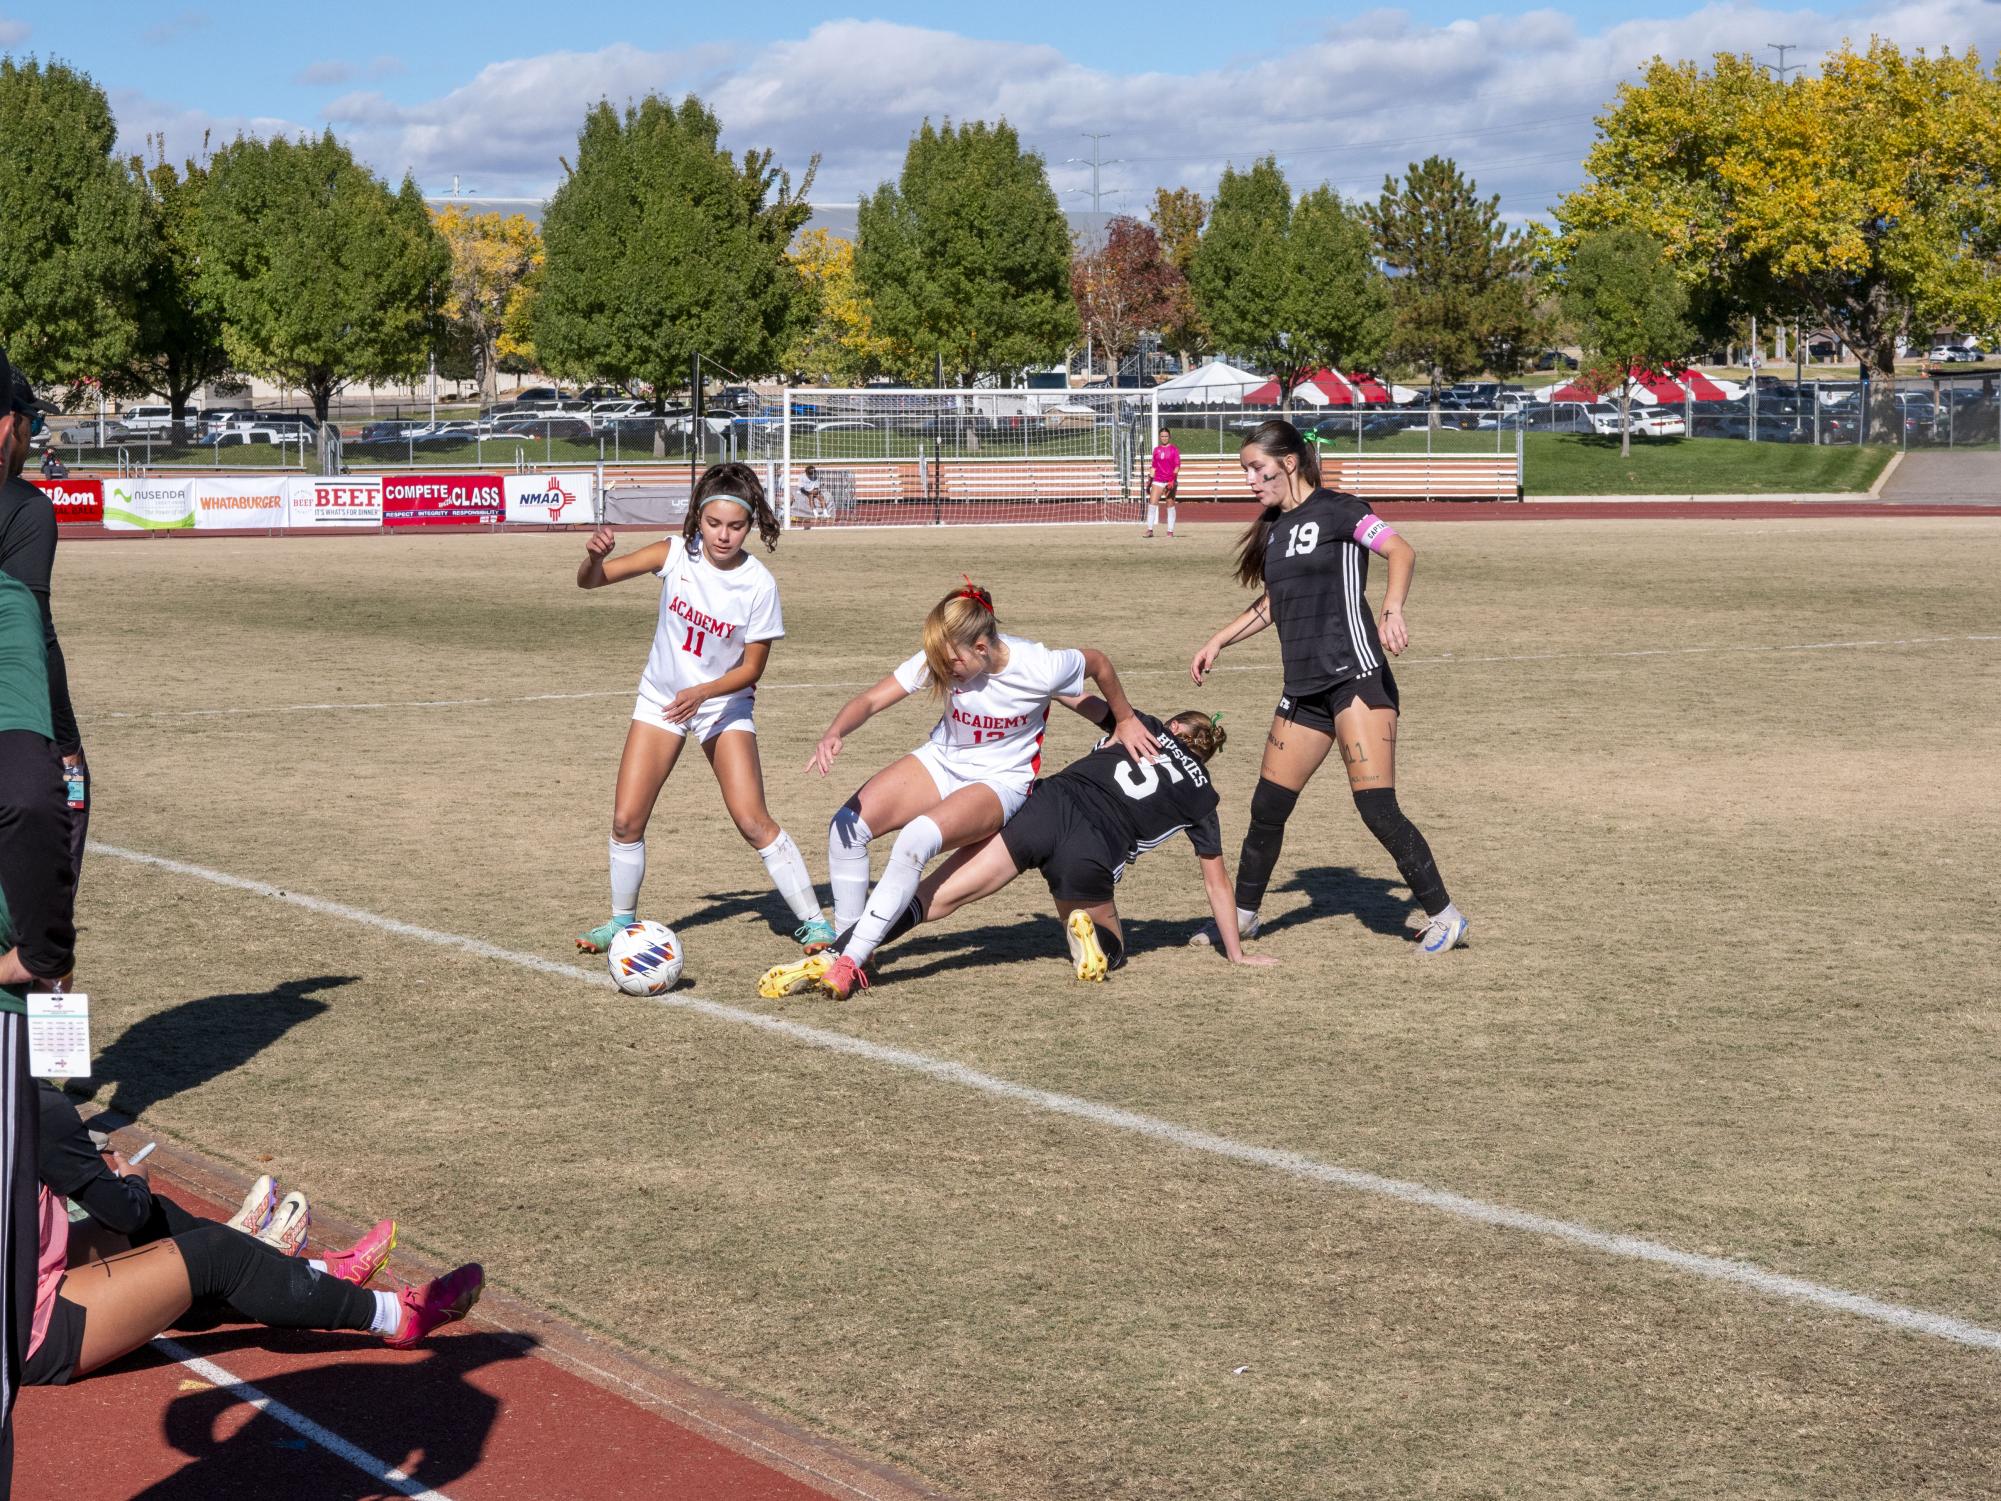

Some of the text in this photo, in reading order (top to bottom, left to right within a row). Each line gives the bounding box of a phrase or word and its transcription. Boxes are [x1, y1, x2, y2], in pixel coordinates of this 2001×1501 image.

[39, 487, 95, 506] ilson
[134, 490, 185, 500] NUSENDA
[385, 484, 449, 499] COMPETE
[451, 486, 500, 507] CLASS
[519, 493, 560, 504] NMAA
[200, 495, 281, 511] WHATABURGER
[293, 498, 314, 507] BEEF
[452, 509, 499, 517] RESPONSIBILITY
[1285, 521, 1320, 557] 19
[668, 595, 737, 639] ACADEMY
[681, 625, 706, 657] 11
[951, 708, 1028, 729] ACADEMY
[1156, 732, 1209, 788] HUSKIES
[1113, 753, 1184, 800] 5
